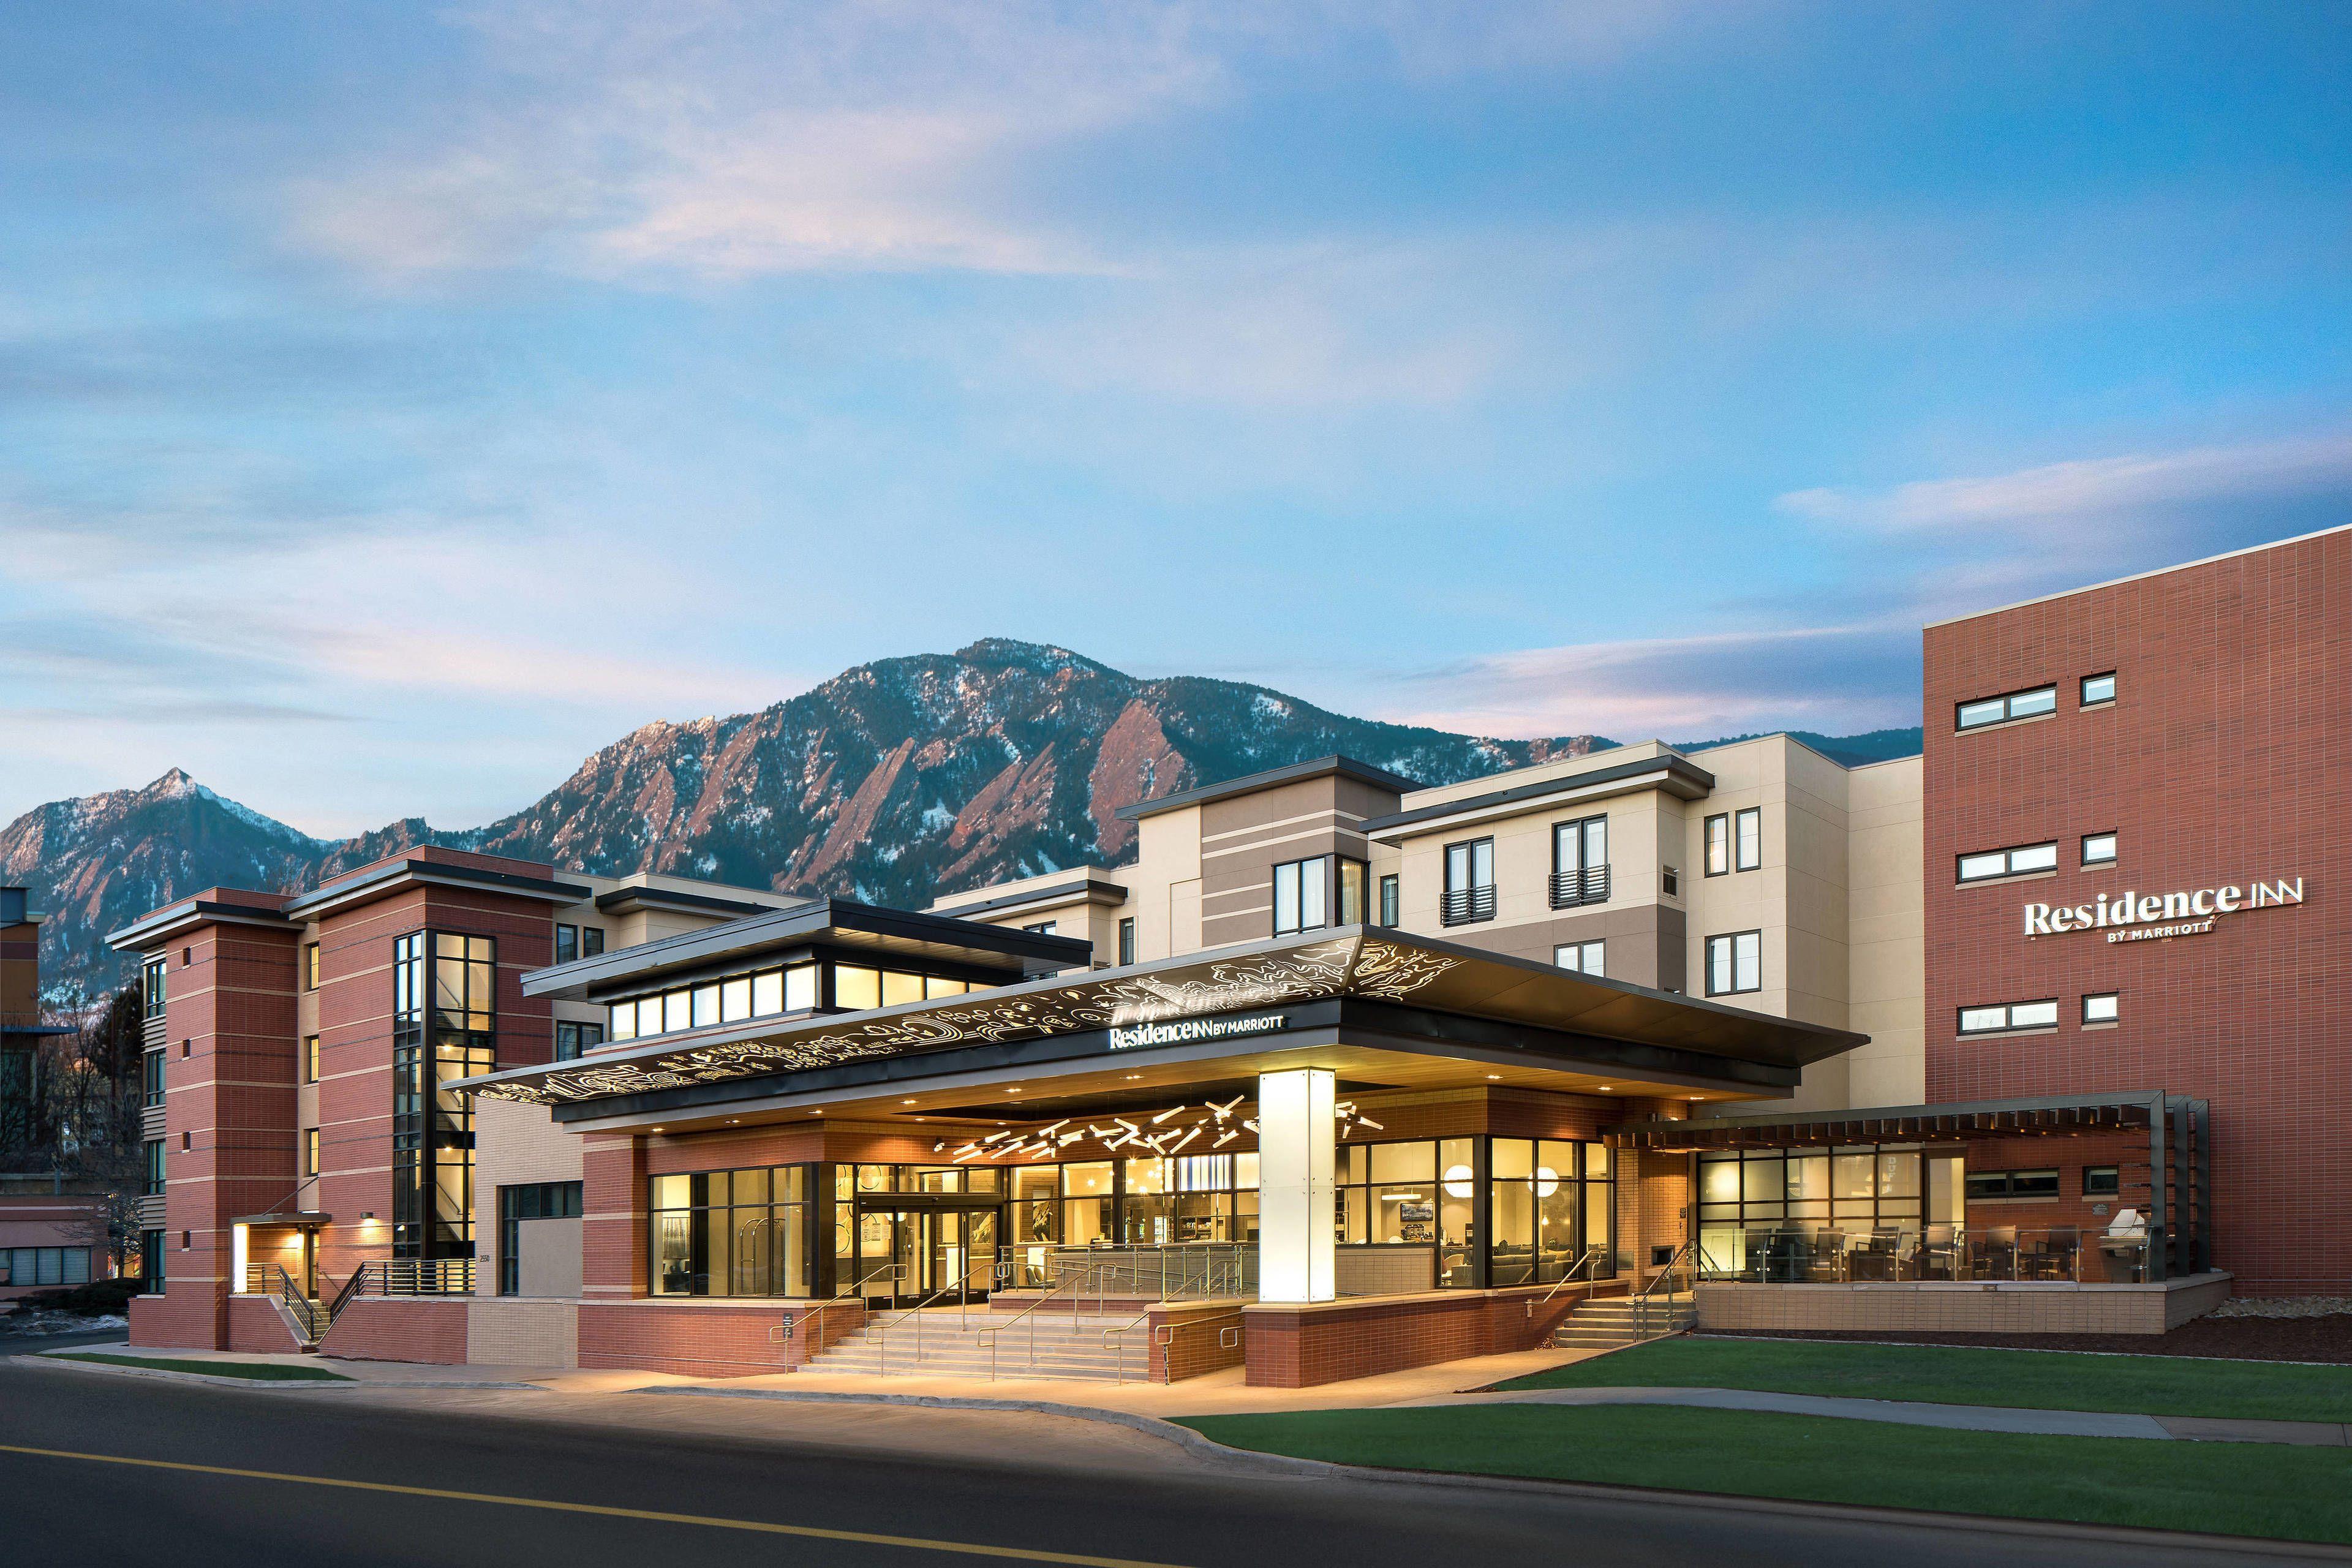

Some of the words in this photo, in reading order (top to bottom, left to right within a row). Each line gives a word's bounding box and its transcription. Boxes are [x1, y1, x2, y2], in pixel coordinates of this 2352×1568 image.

[2024, 886, 2242, 935] Residence
[2252, 877, 2302, 908] INN
[2107, 929, 2127, 943] BY
[2132, 919, 2213, 941] MARRIOTT
[1109, 1022, 1192, 1049] Residence
[1213, 1022, 1227, 1036] BY
[1227, 1015, 1284, 1034] MARRIOTT
